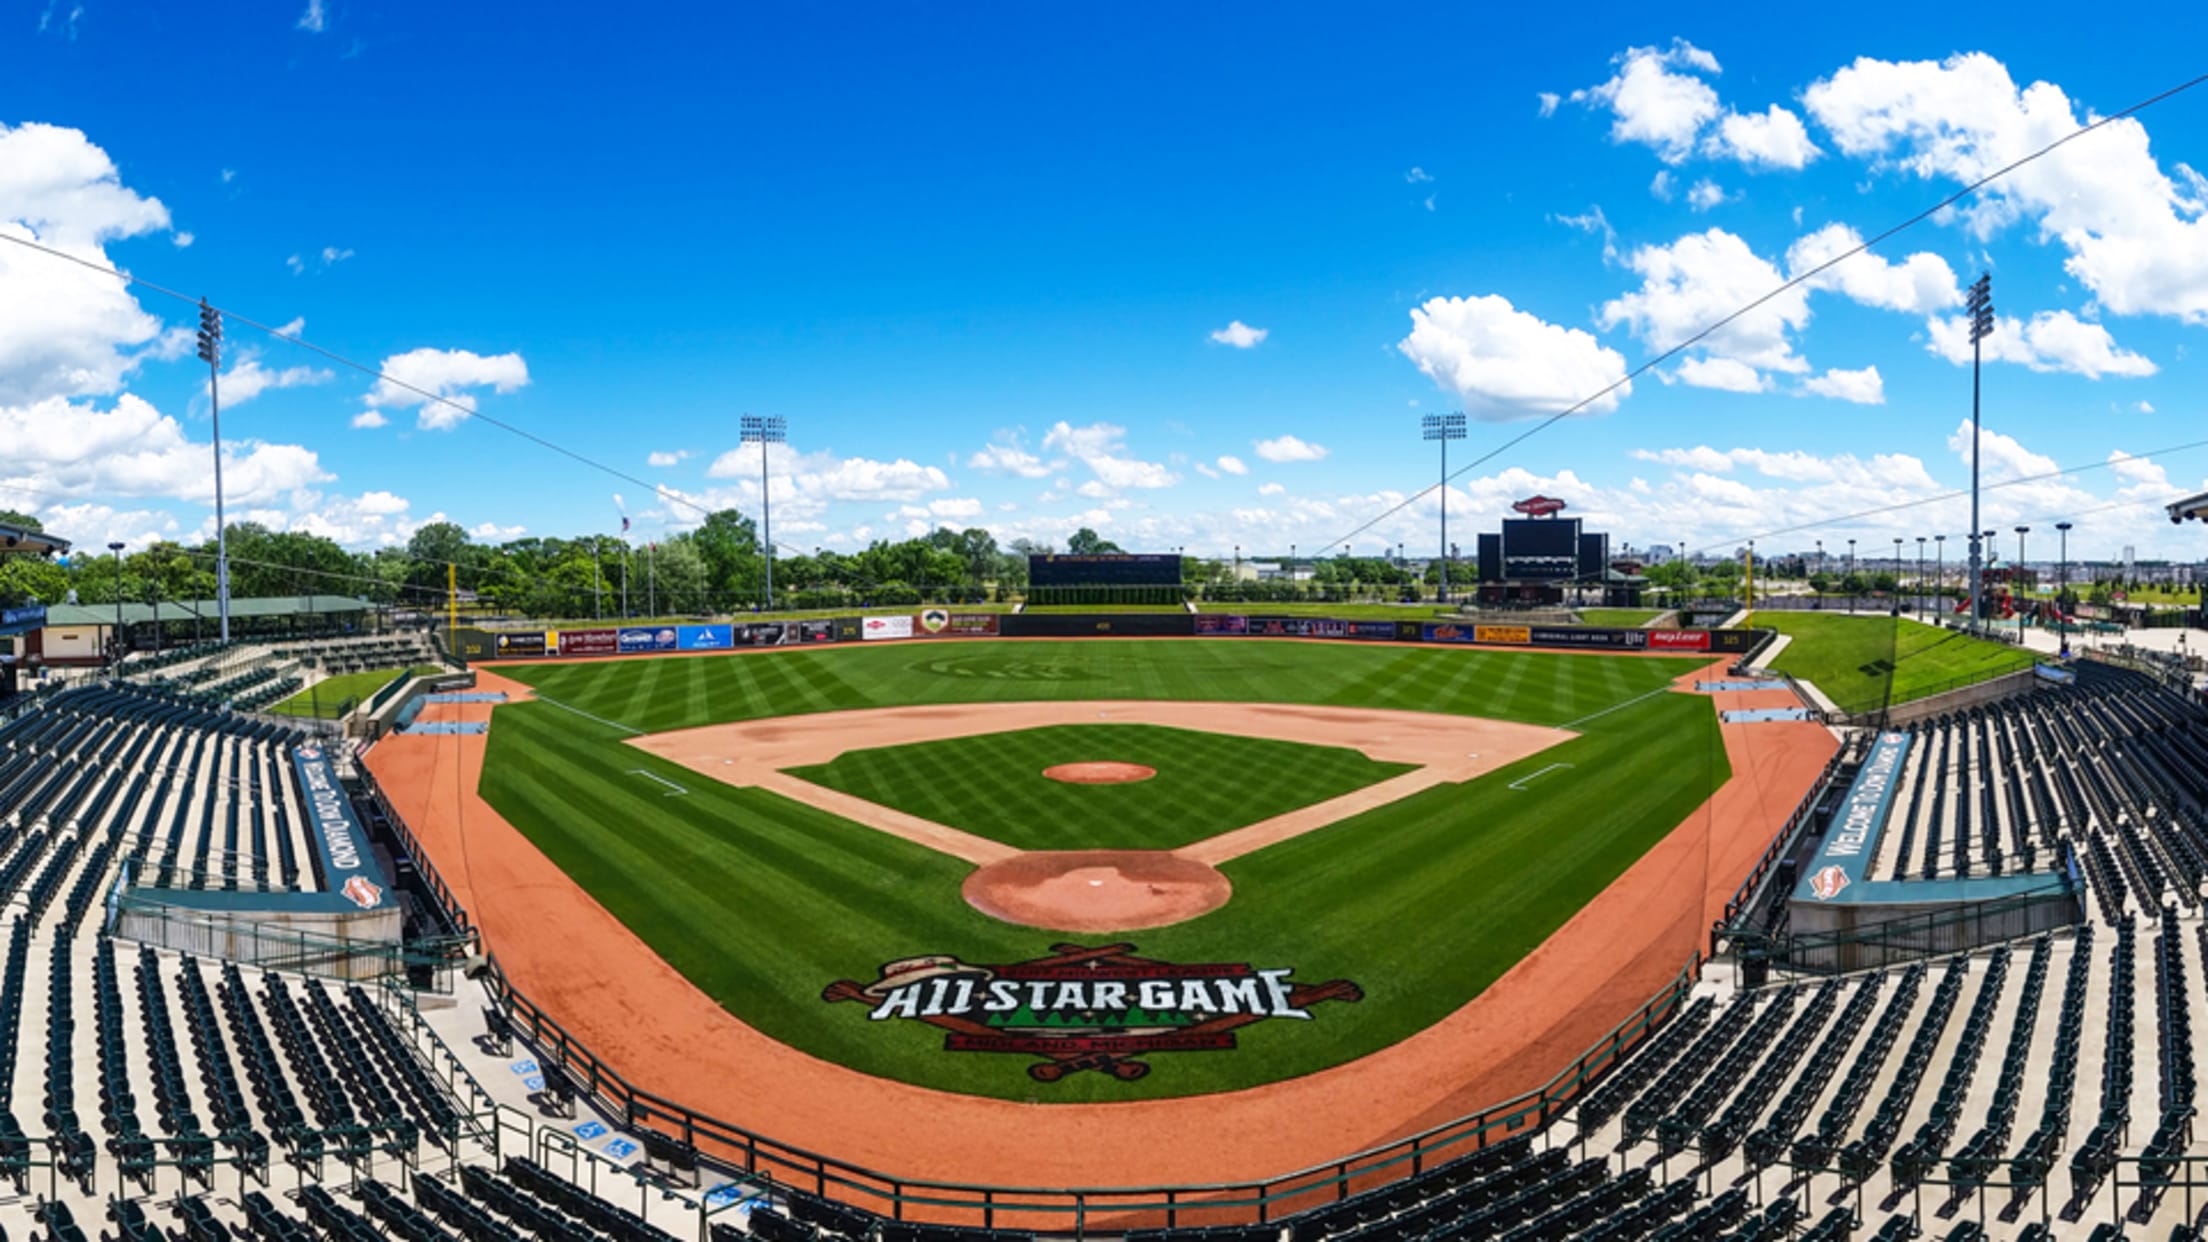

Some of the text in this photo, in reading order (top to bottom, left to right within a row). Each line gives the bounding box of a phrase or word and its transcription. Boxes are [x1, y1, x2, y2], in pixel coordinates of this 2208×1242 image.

[1825, 804, 1877, 856] WELCOME
[983, 981, 1128, 1011] STAR
[1138, 968, 1312, 1020] GAME
